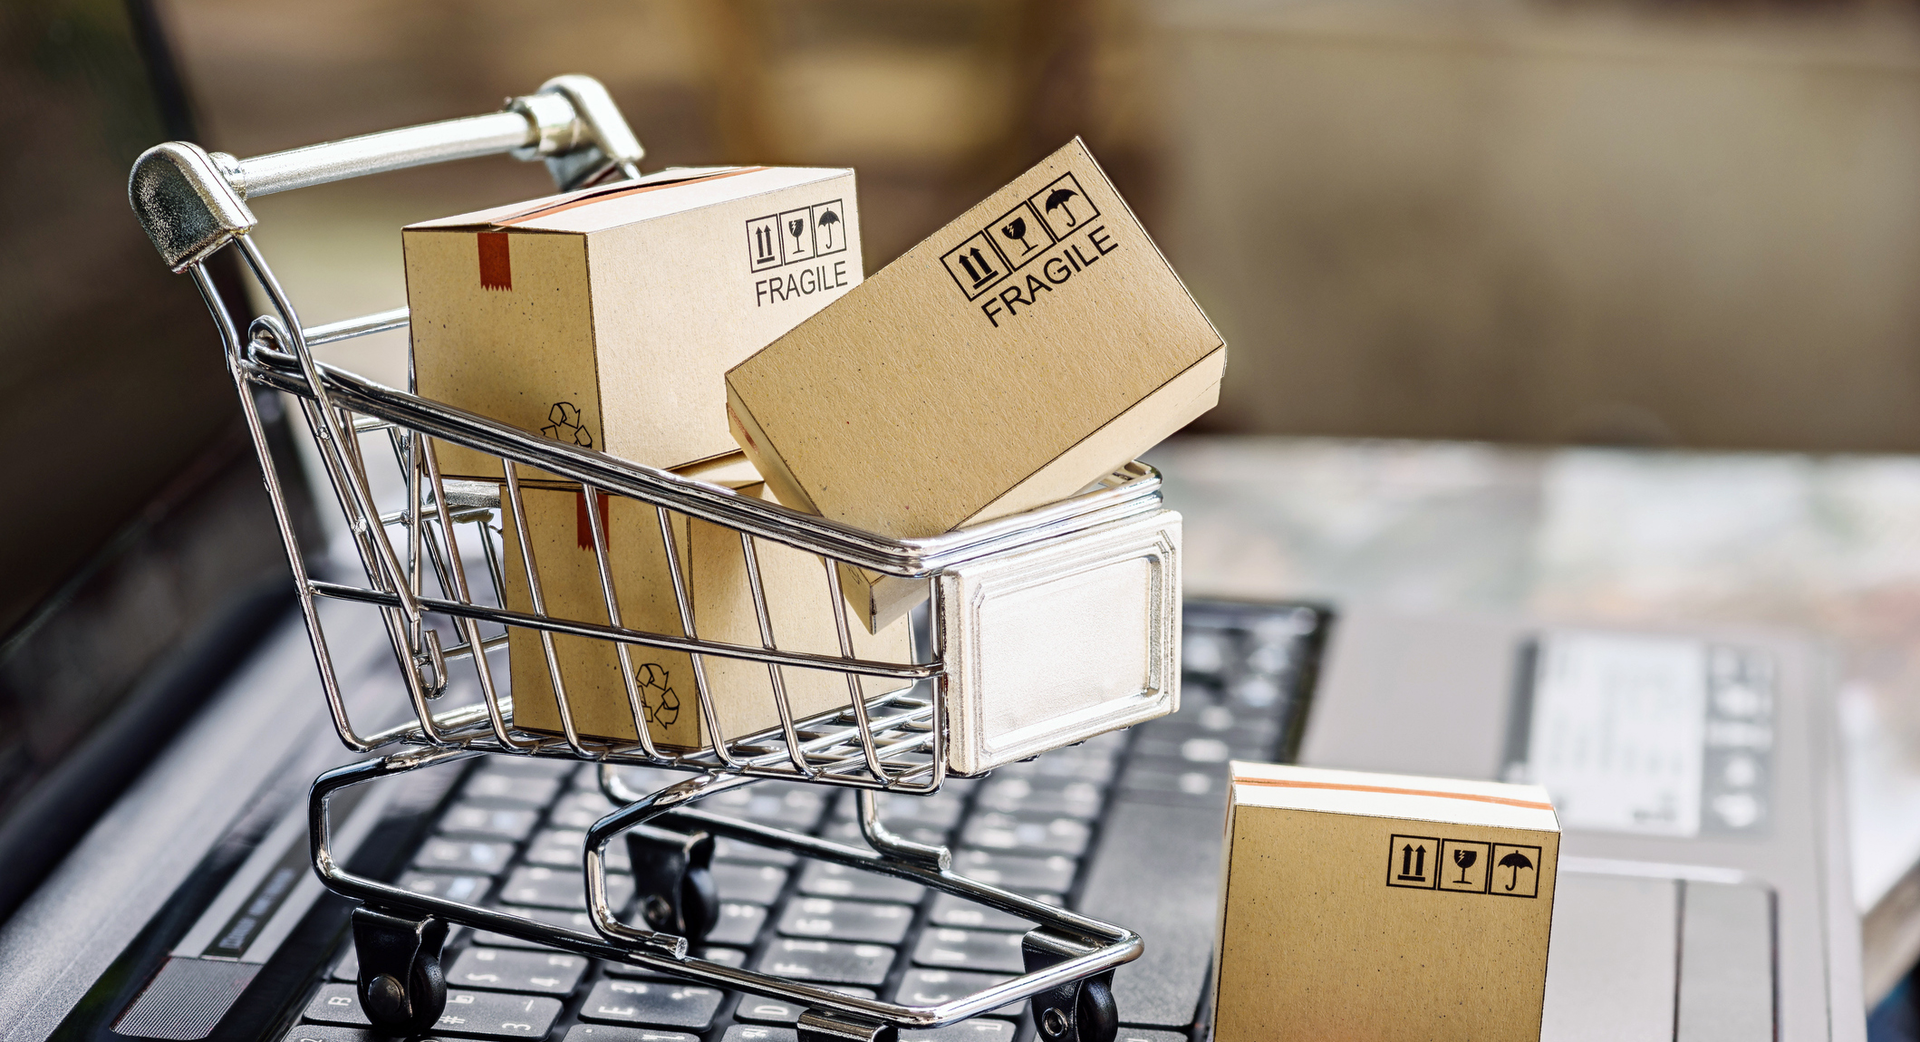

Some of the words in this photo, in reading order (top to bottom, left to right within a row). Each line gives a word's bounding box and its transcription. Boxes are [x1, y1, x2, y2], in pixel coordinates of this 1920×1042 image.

[981, 225, 1119, 328] FRAGILE
[755, 260, 848, 307] FRAGILE
[530, 976, 561, 988] 4
[598, 1005, 635, 1016] E
[753, 1004, 790, 1017] D
[501, 1022, 532, 1032] 3
